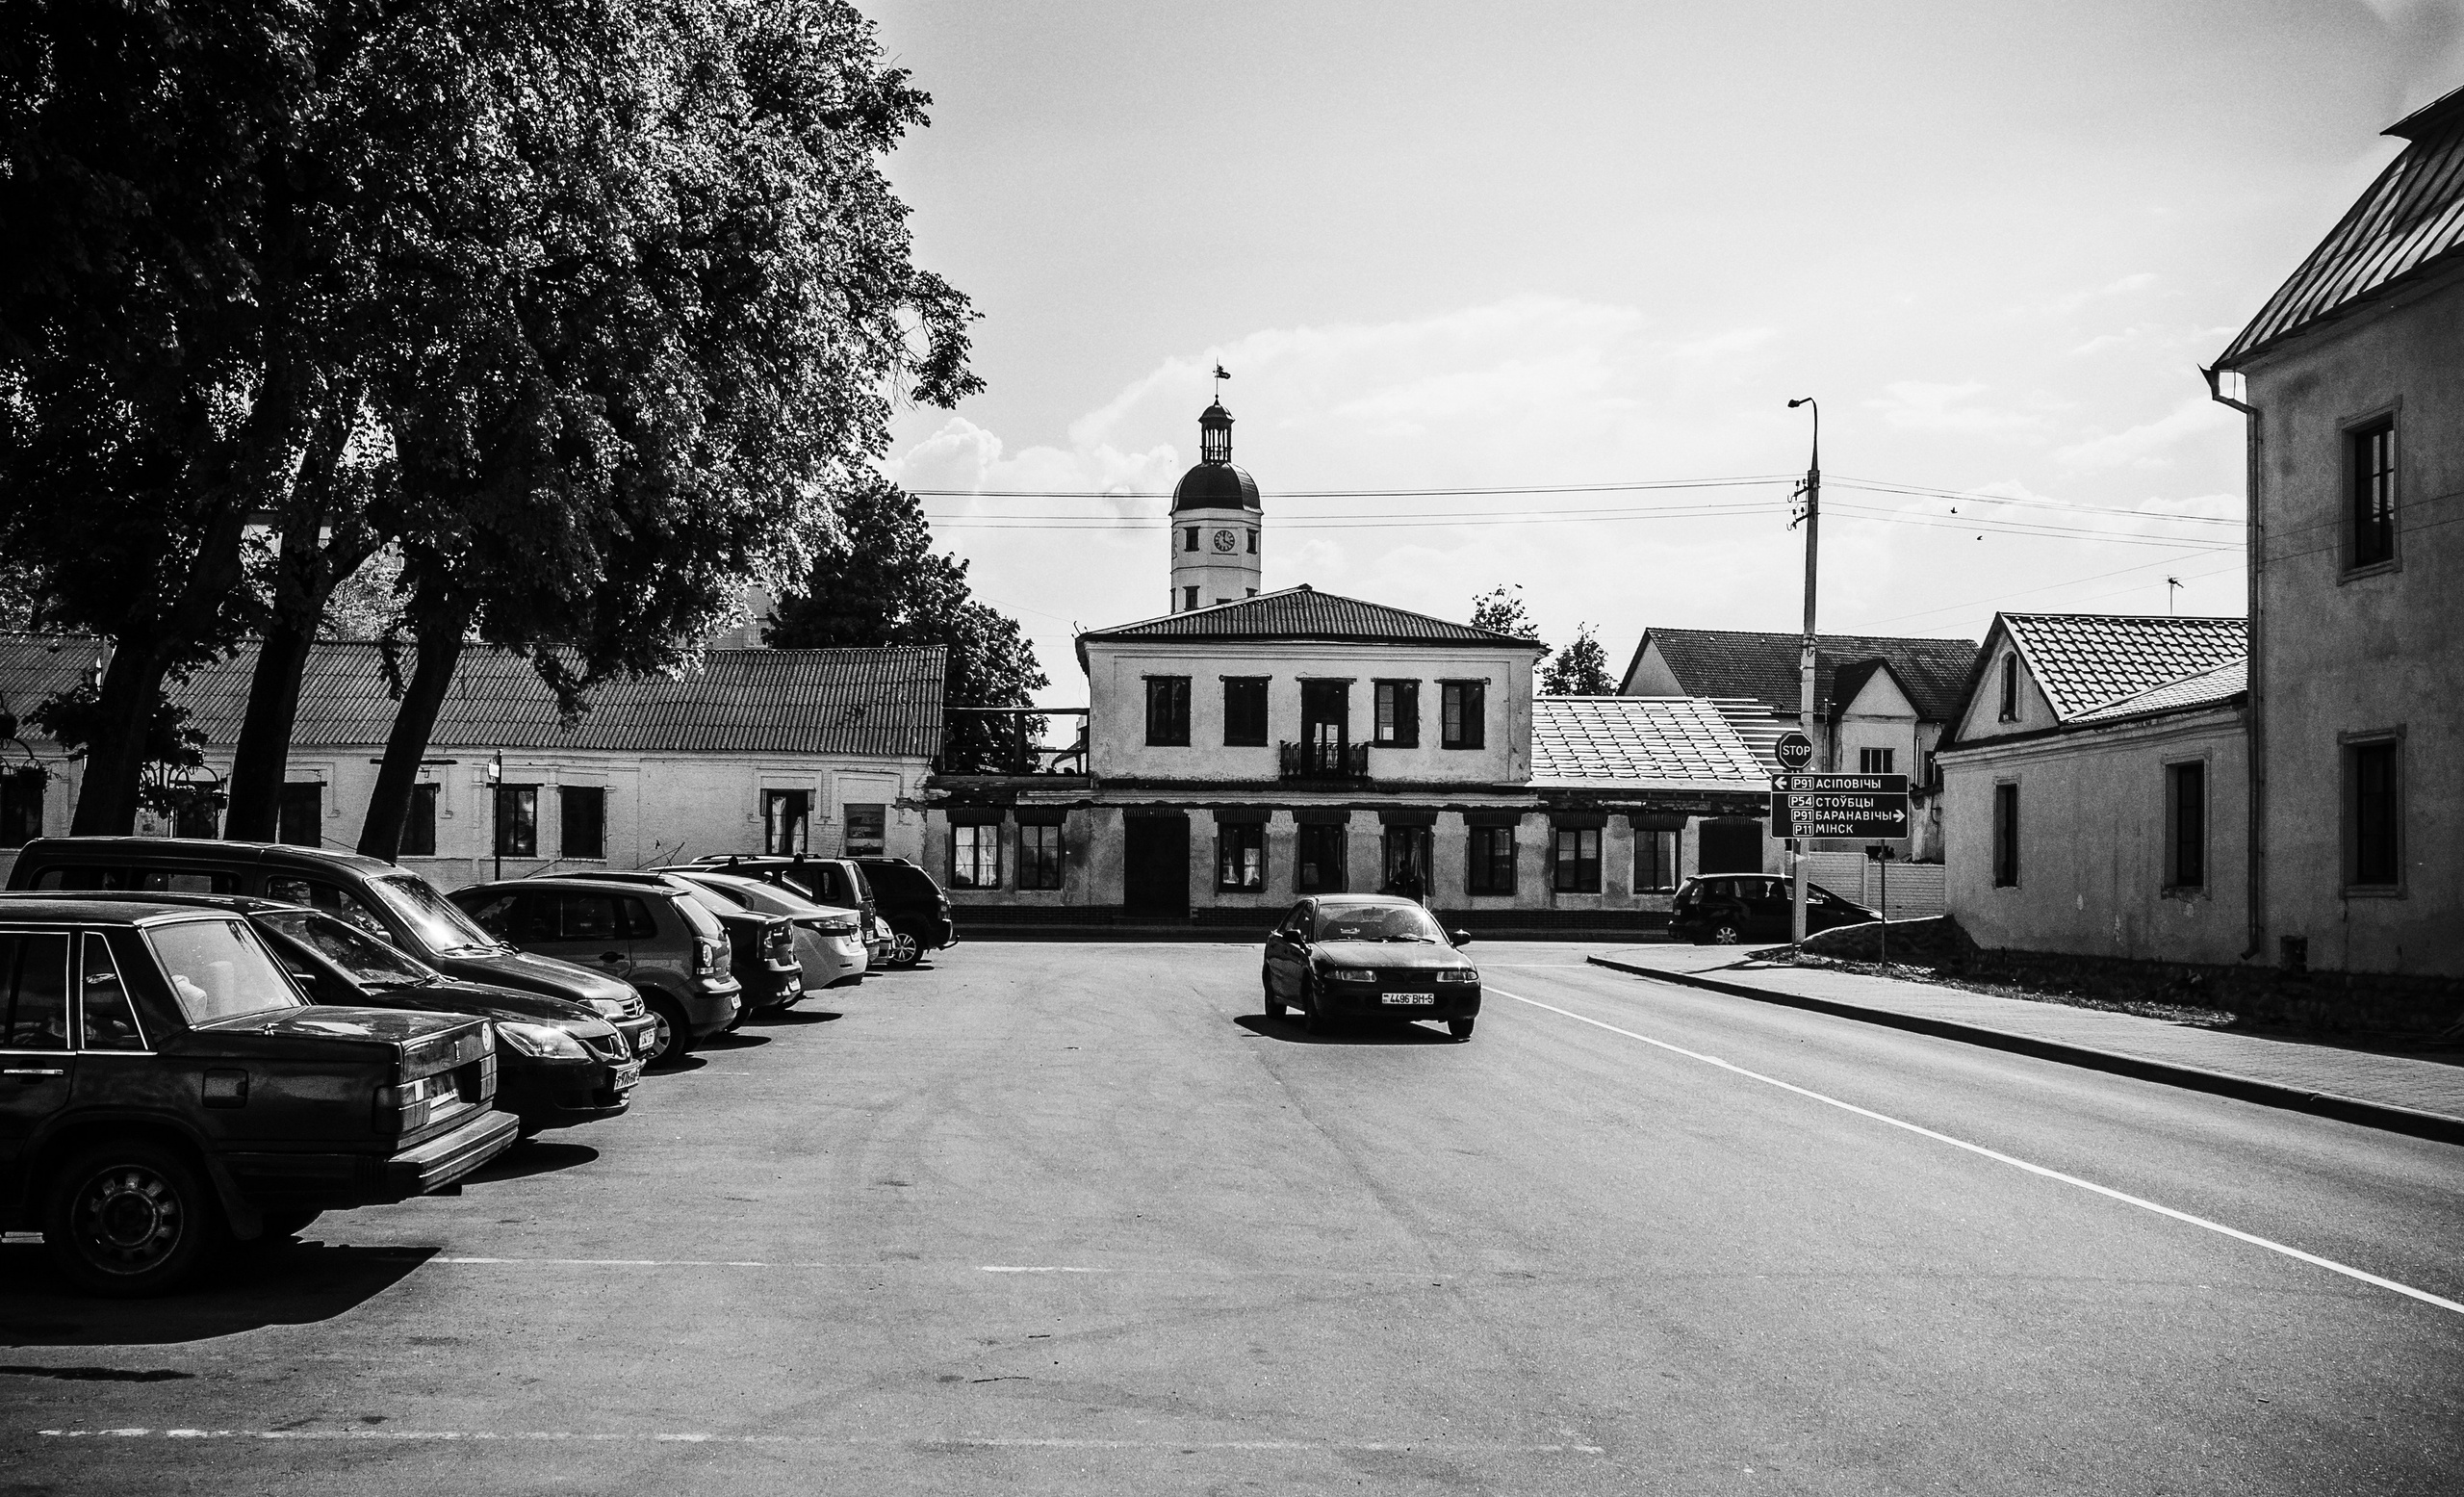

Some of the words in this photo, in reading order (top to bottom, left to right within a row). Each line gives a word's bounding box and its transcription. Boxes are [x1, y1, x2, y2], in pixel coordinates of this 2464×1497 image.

[1783, 745, 1810, 756] STOP
[1815, 779, 1881, 788] АСІПОВІЧЫ
[1815, 795, 1873, 809] СТОЎБЦЫ
[1815, 812, 1891, 820] БАРАНАВІЧЫ
[1815, 824, 1853, 833] МІНСК
[1390, 994, 1409, 1004] 4496
